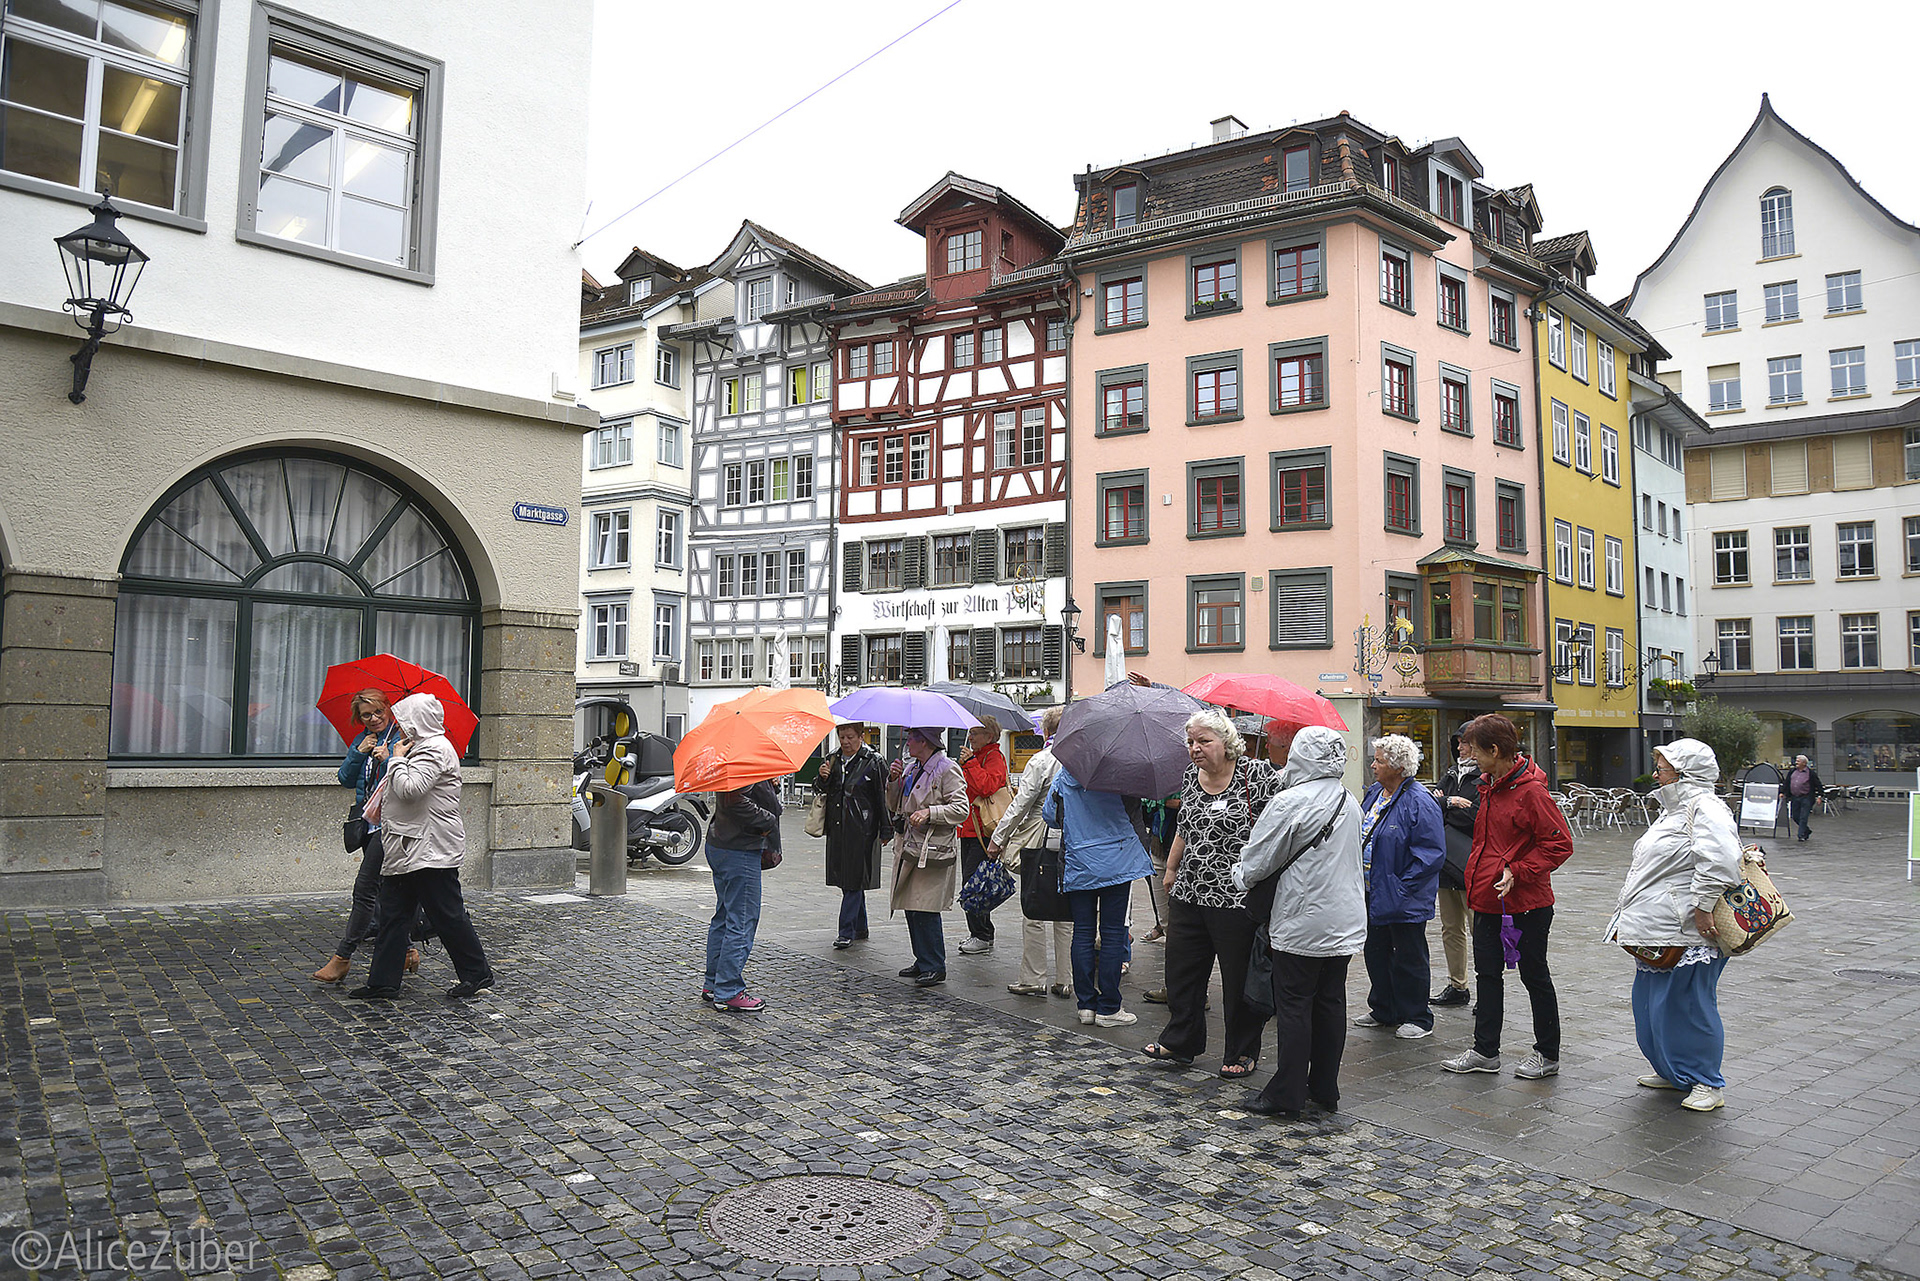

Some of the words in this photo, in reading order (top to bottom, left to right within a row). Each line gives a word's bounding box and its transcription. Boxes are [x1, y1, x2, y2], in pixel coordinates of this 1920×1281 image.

[518, 505, 564, 521] Marktgasse
[873, 597, 936, 621] Wirtschaft
[941, 601, 959, 618] zur
[963, 594, 999, 613] Alten
[1003, 591, 1034, 615] Post
